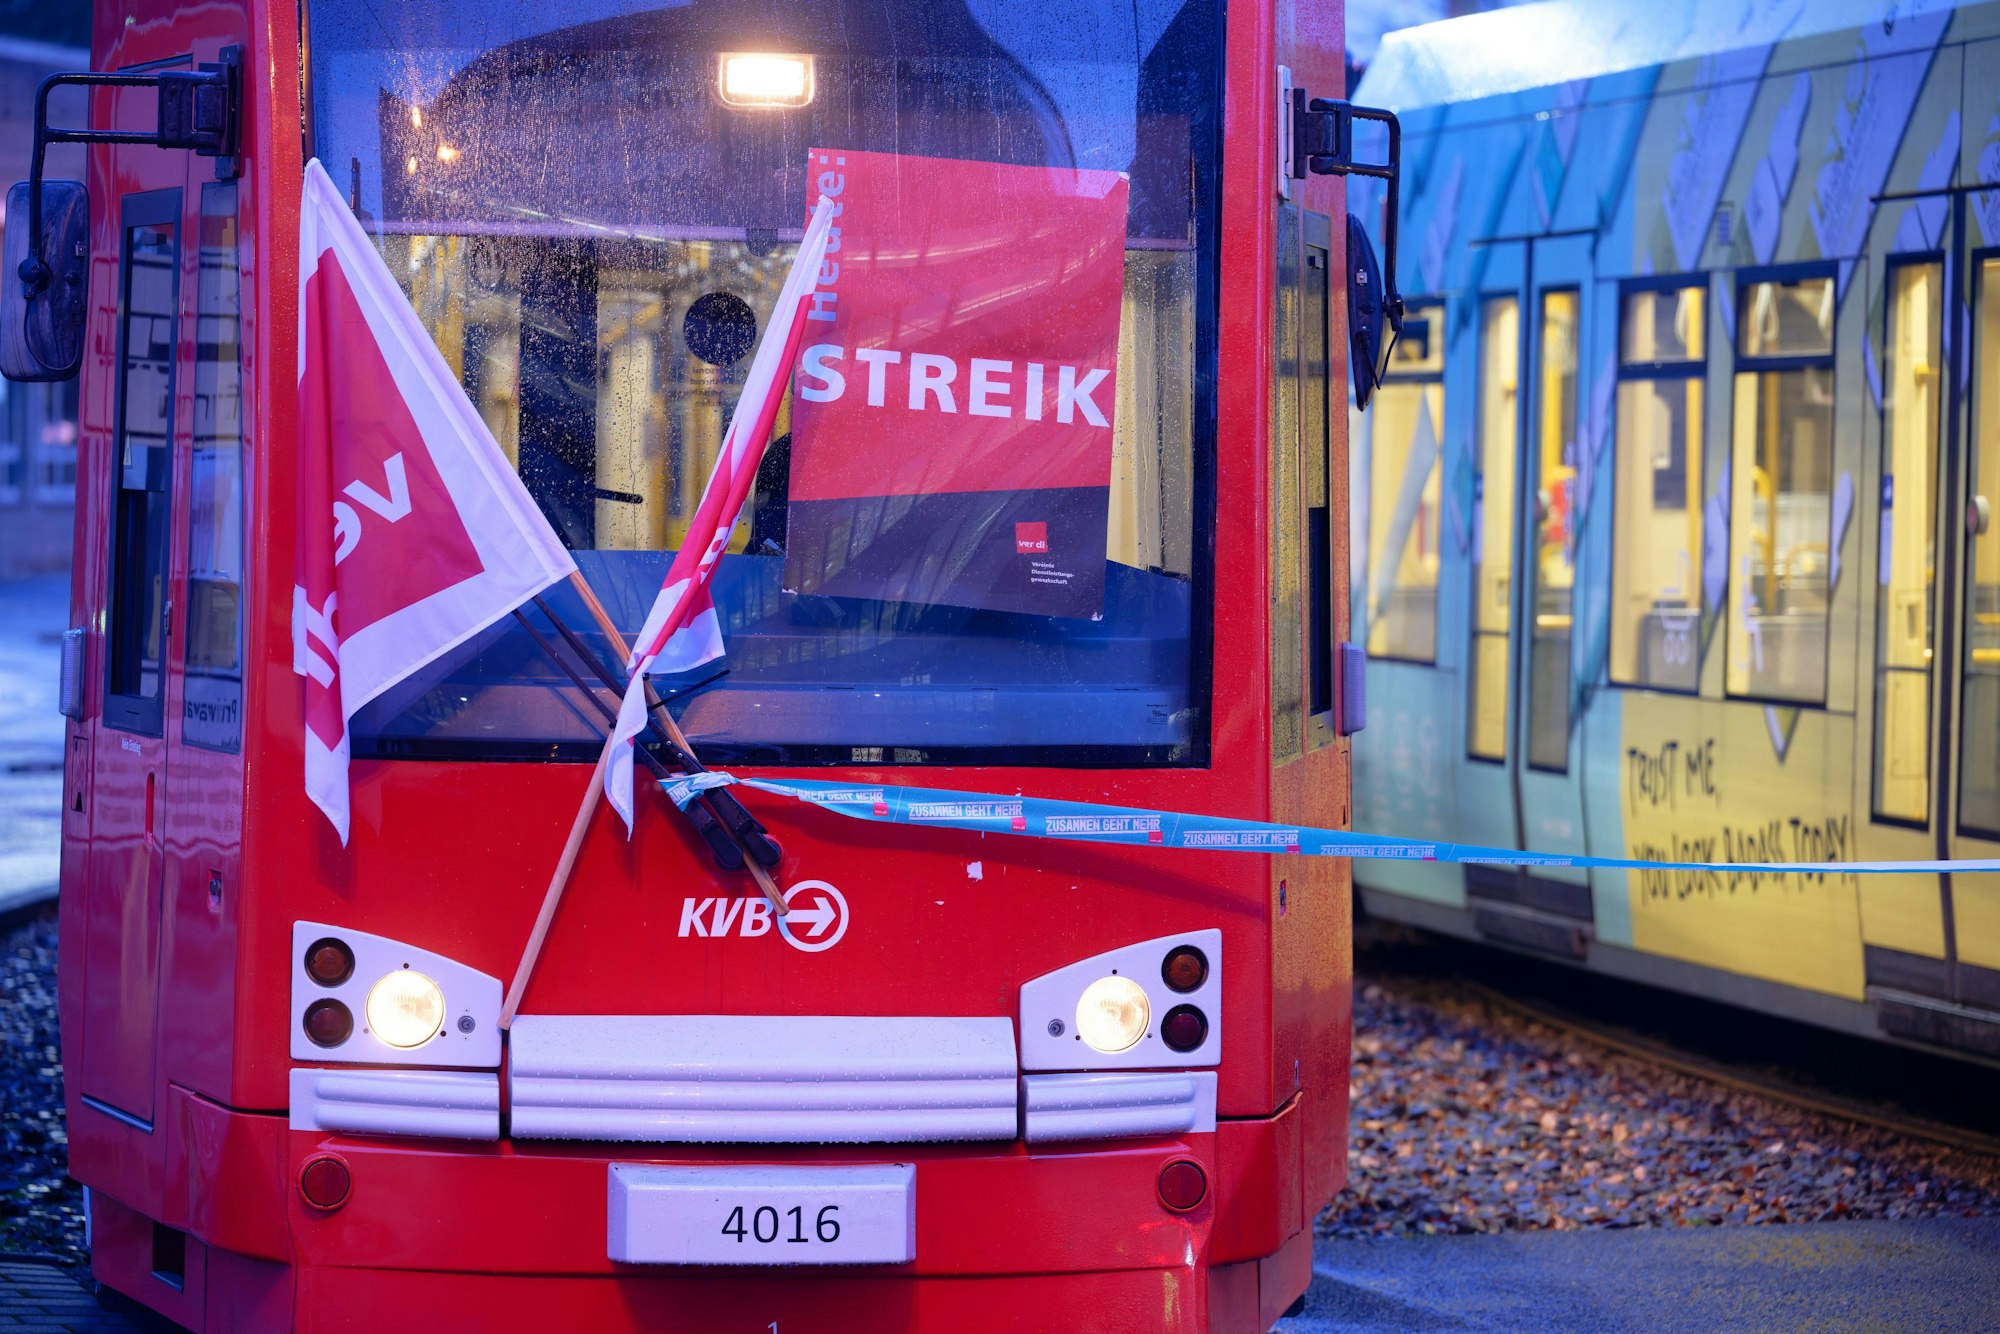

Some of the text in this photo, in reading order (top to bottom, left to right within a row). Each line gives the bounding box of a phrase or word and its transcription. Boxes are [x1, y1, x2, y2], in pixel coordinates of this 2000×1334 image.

[800, 343, 1111, 428] STREIK
[1627, 740, 1679, 819] TRUST
[856, 791, 884, 803] MEHR
[908, 803, 1023, 818] ZUSAMMEN GEHT MEHR
[1045, 818, 1161, 833] ZUSAMMEN GEHT MEHR
[1183, 832, 1299, 846] ZUSAMMEN GEHT MEHR
[1320, 847, 1436, 857] ZUSAMMEN GEHT MEHR
[677, 897, 775, 937] KVB
[721, 1205, 842, 1244] 4016
